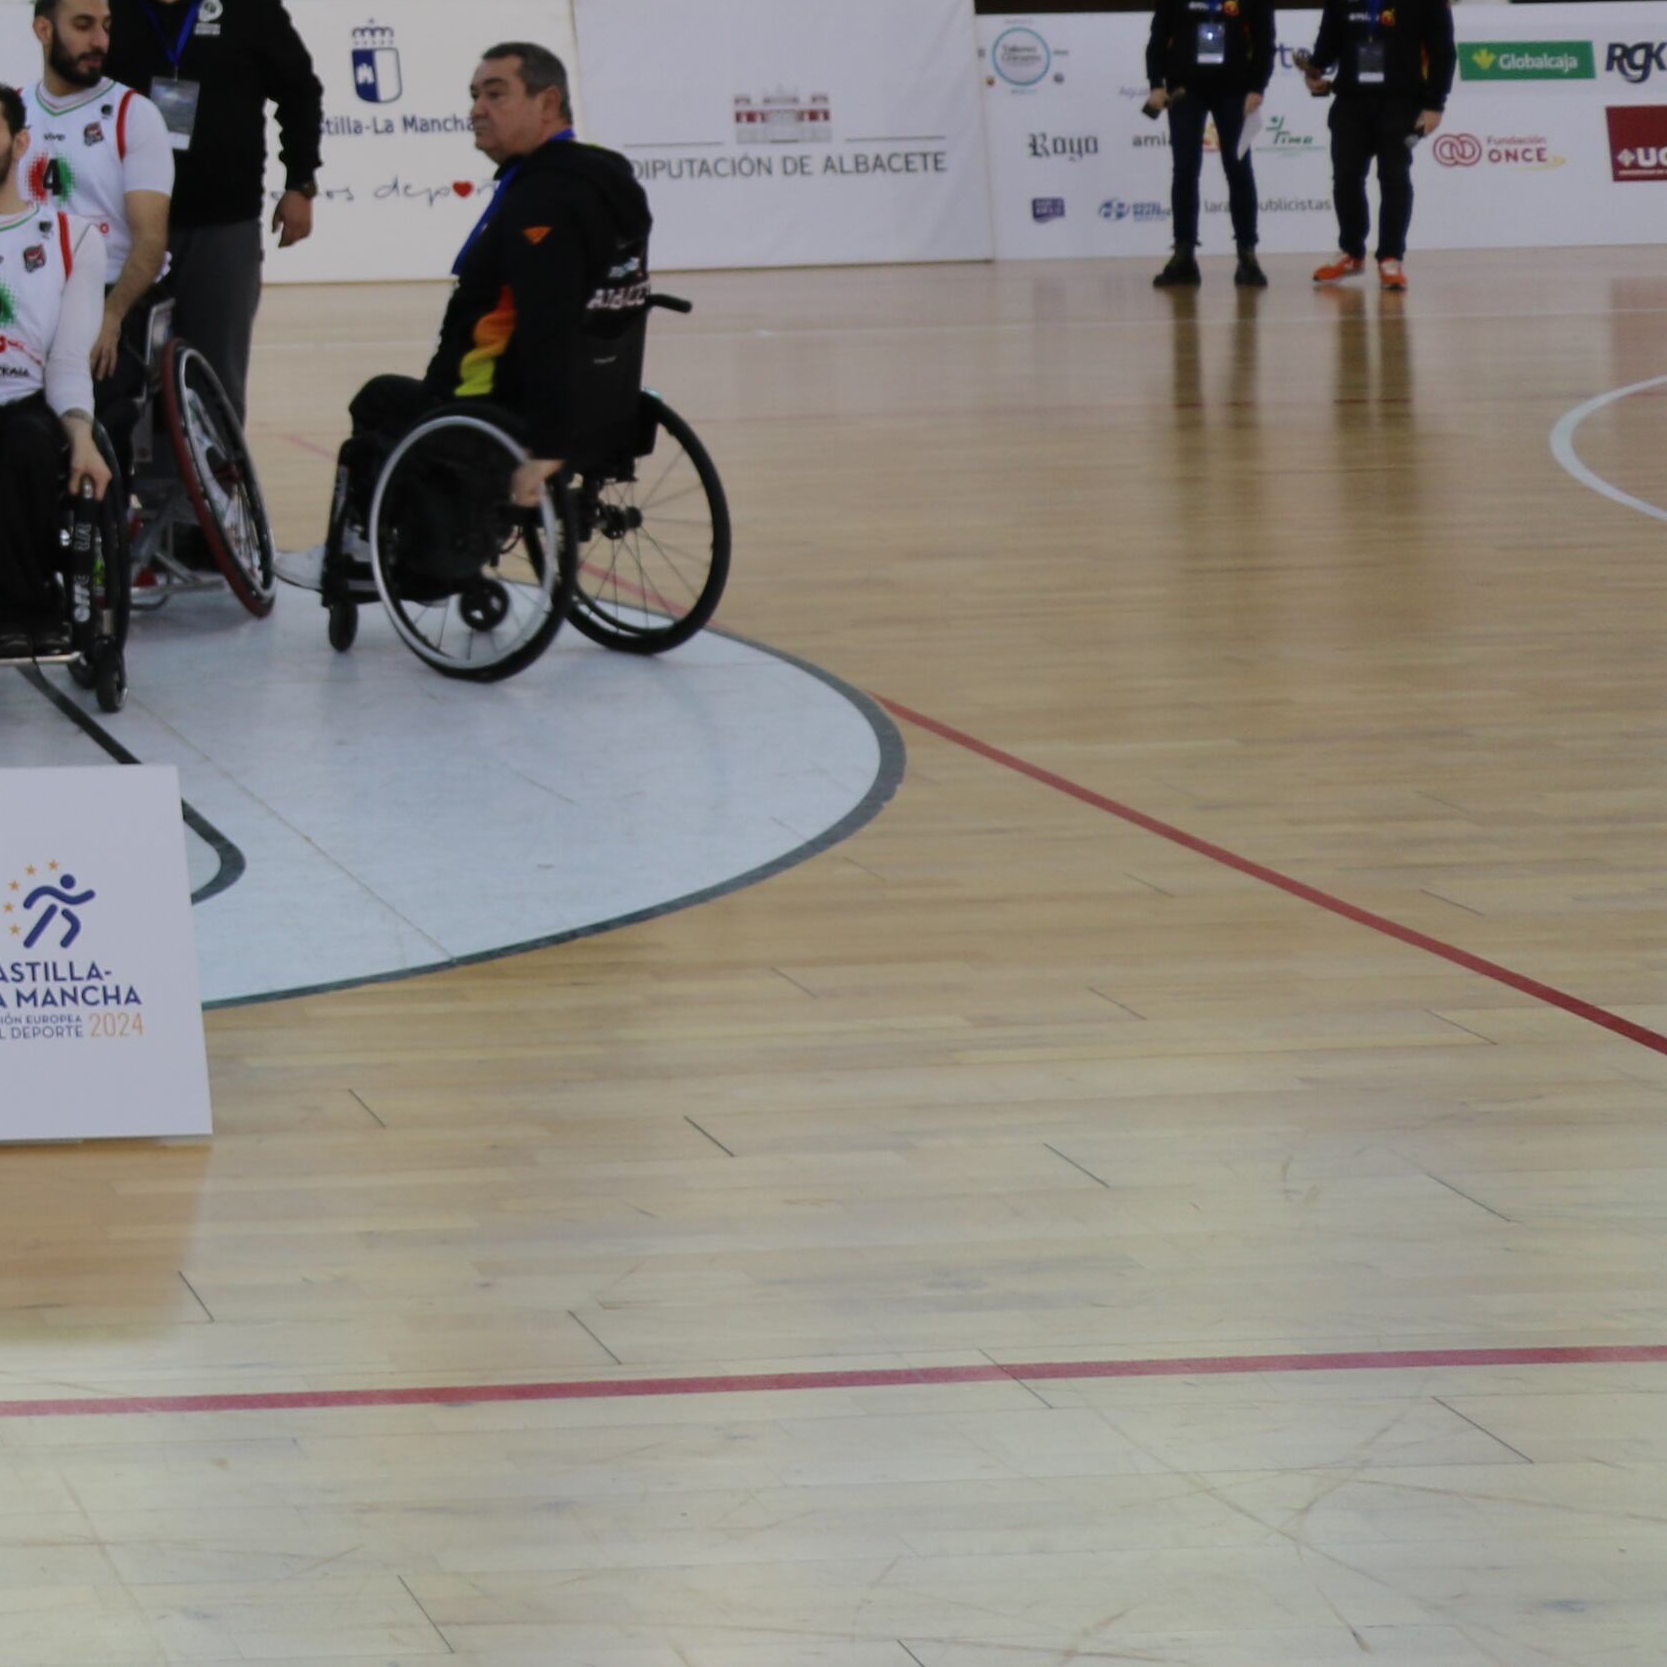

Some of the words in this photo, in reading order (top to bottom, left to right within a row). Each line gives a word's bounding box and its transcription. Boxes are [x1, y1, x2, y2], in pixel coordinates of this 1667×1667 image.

[1498, 51, 1579, 73] Globalcaja
[783, 156, 812, 177] DE
[822, 152, 949, 177] ALBACETE
[1487, 147, 1547, 163] ONCE
[42, 158, 63, 196] 4
[1259, 197, 1332, 212] ublicistas
[15, 984, 143, 1009] MANCHA
[25, 1013, 83, 1025] EUROPEA
[88, 1011, 145, 1039] 2024
[10, 1024, 84, 1040] DEPORTE
